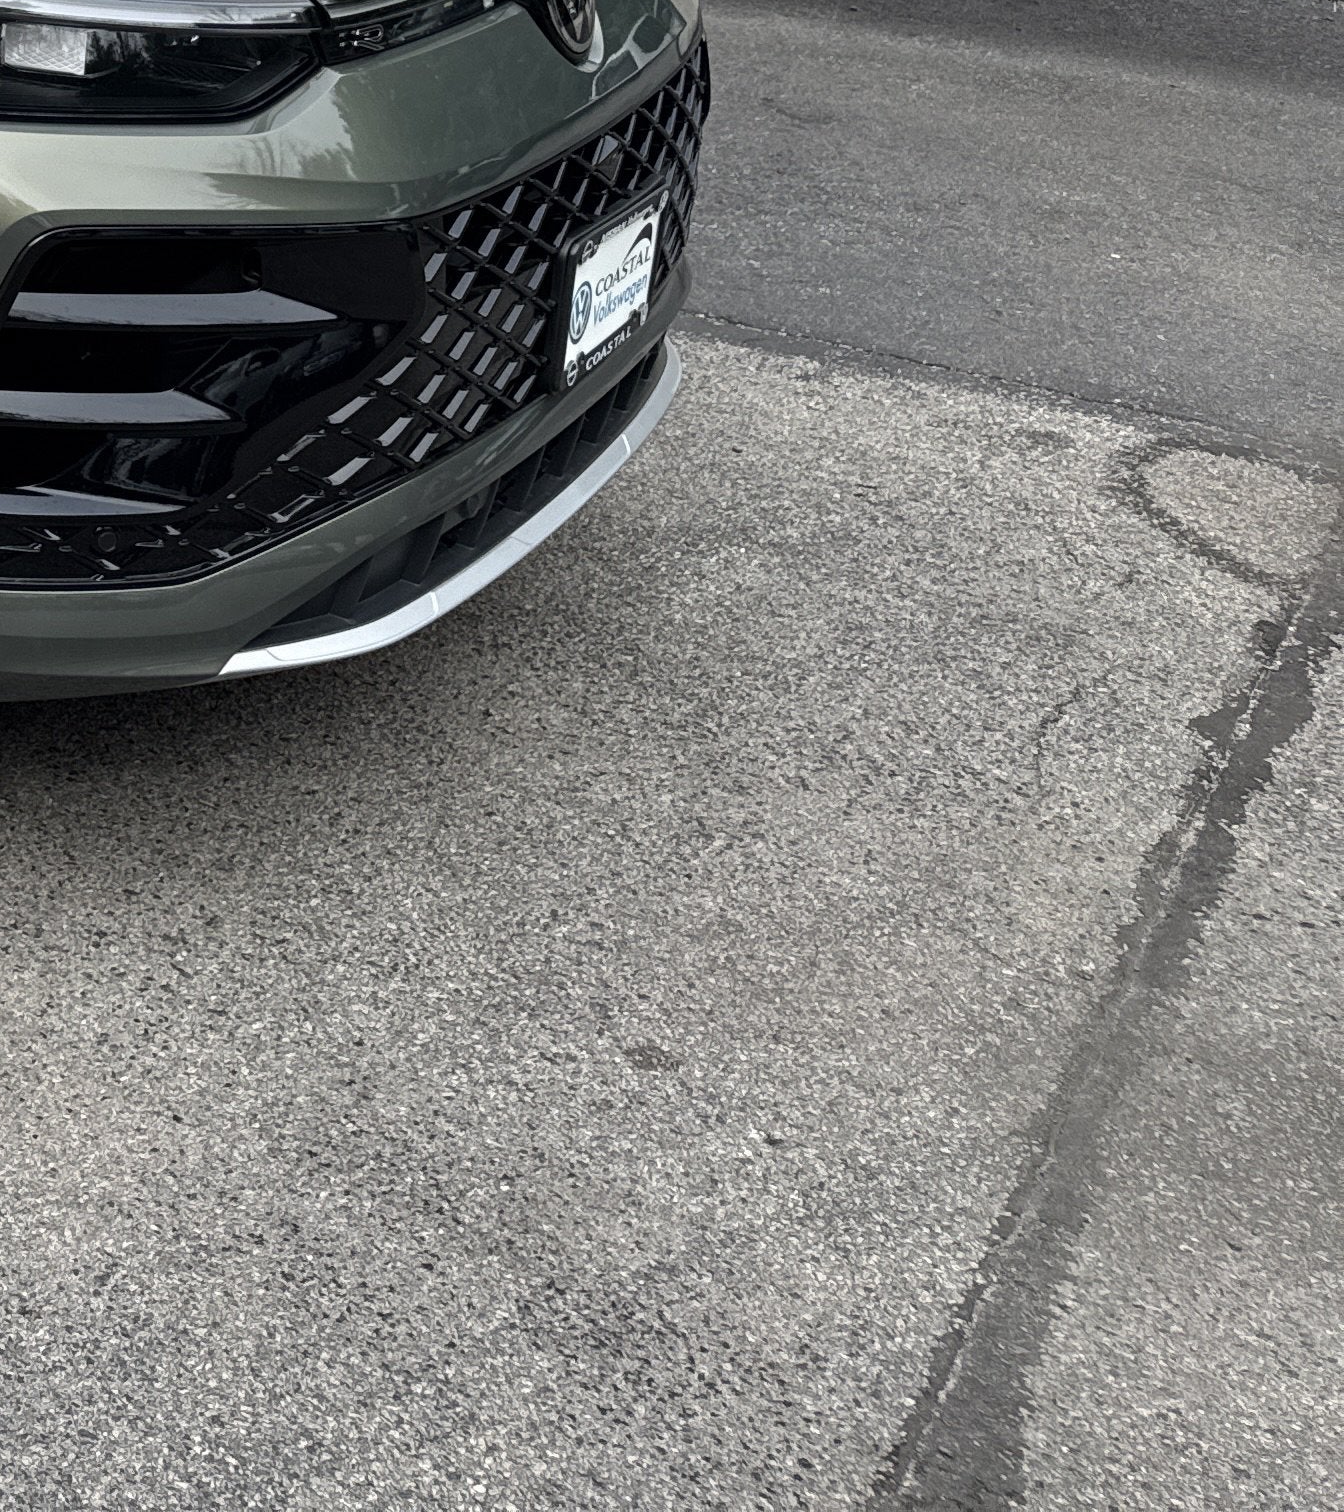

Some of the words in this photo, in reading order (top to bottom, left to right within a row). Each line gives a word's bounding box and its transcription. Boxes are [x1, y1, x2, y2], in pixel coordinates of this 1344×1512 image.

[595, 246, 652, 297] COASTAL
[593, 274, 648, 327] Volkswagen
[585, 325, 632, 372] COASTAL
